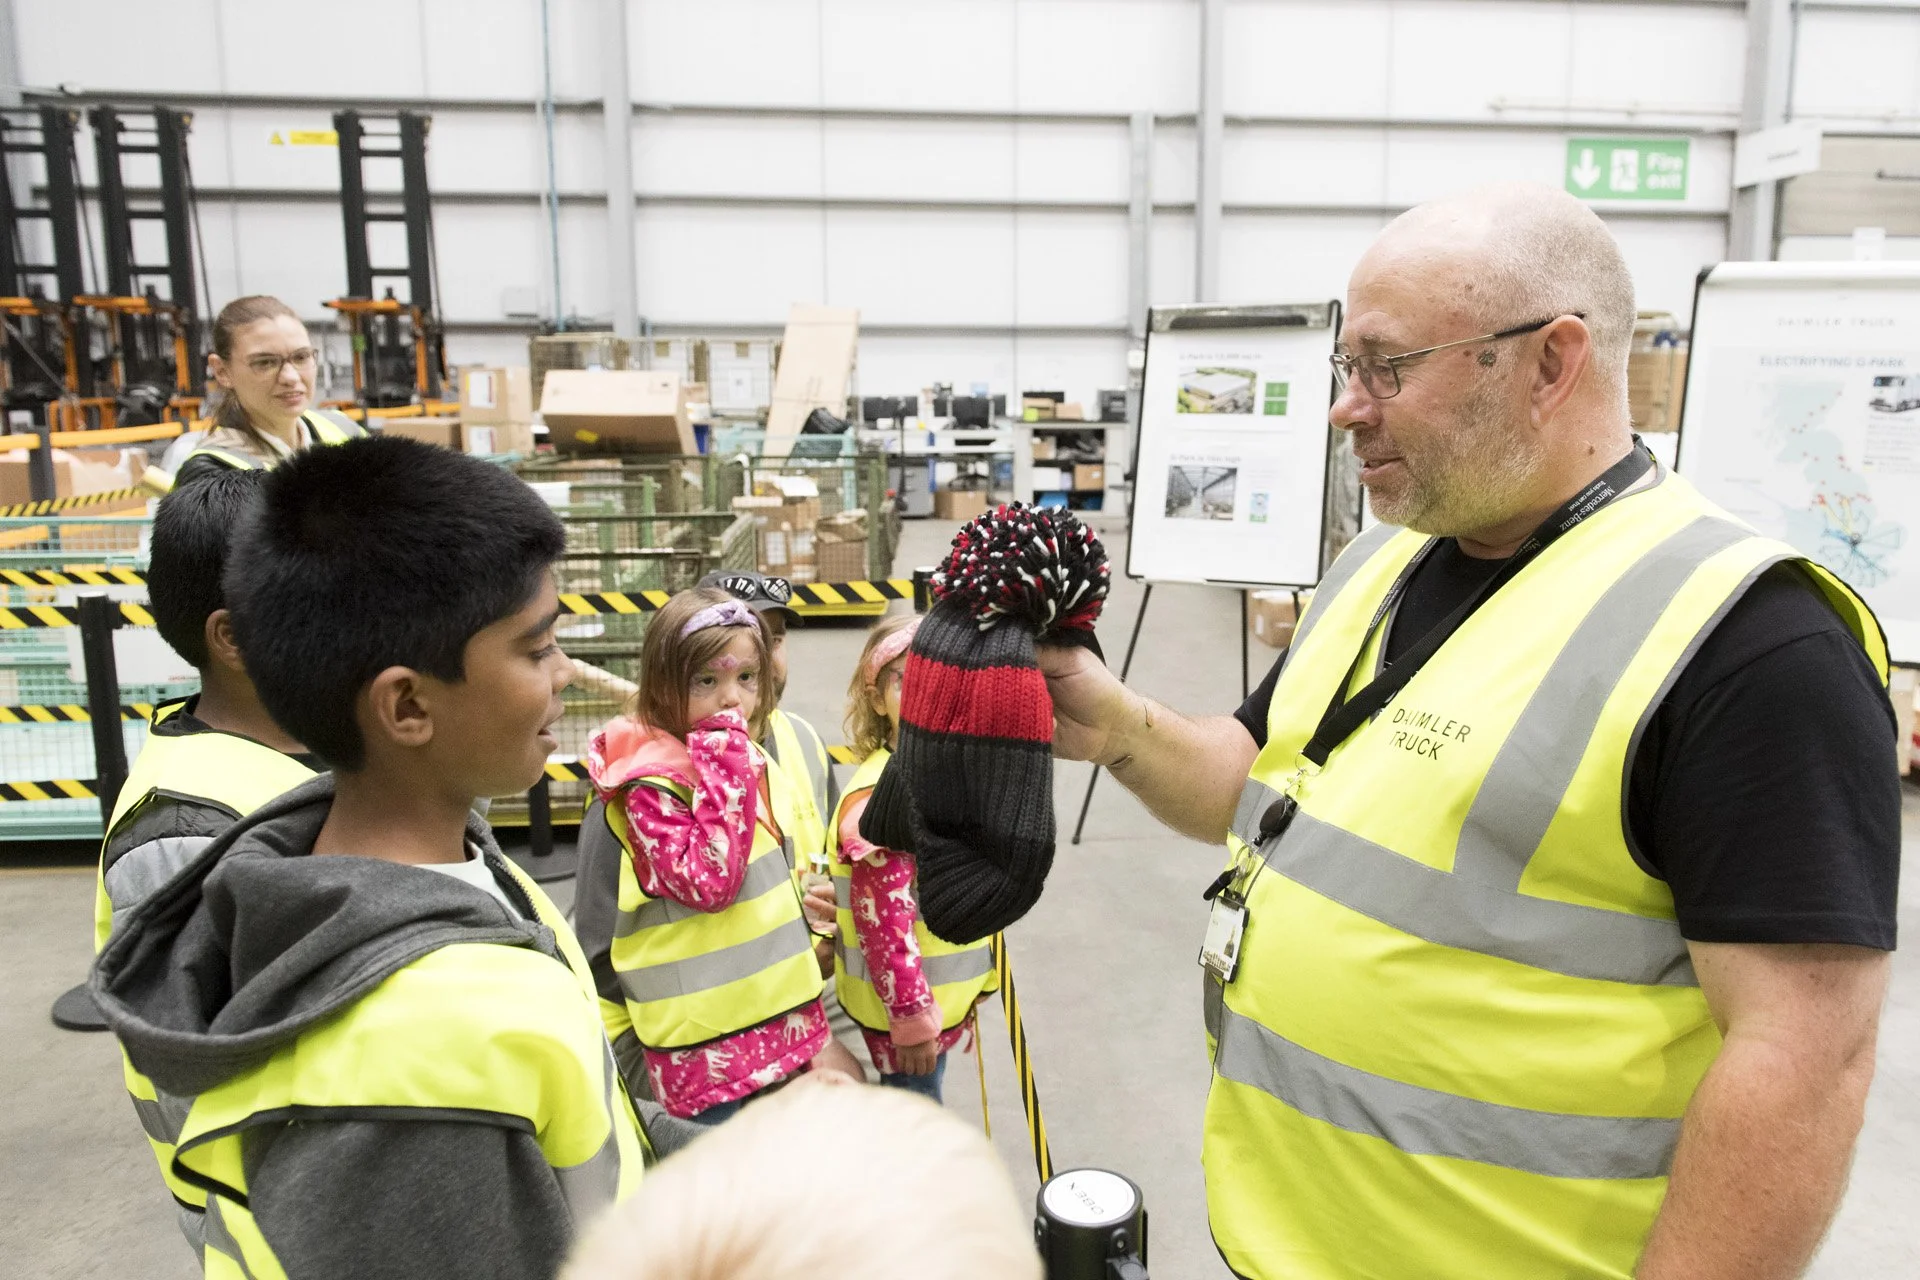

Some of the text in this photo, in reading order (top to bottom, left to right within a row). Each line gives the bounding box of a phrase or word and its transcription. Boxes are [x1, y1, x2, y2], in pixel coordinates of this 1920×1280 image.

[1647, 152, 1683, 171] Fire
[1647, 173, 1682, 189] exit
[1560, 486, 1615, 531] Mercedes-Benz
[1393, 708, 1471, 743] DAIMLER
[1389, 731, 1443, 760] TRUCK
